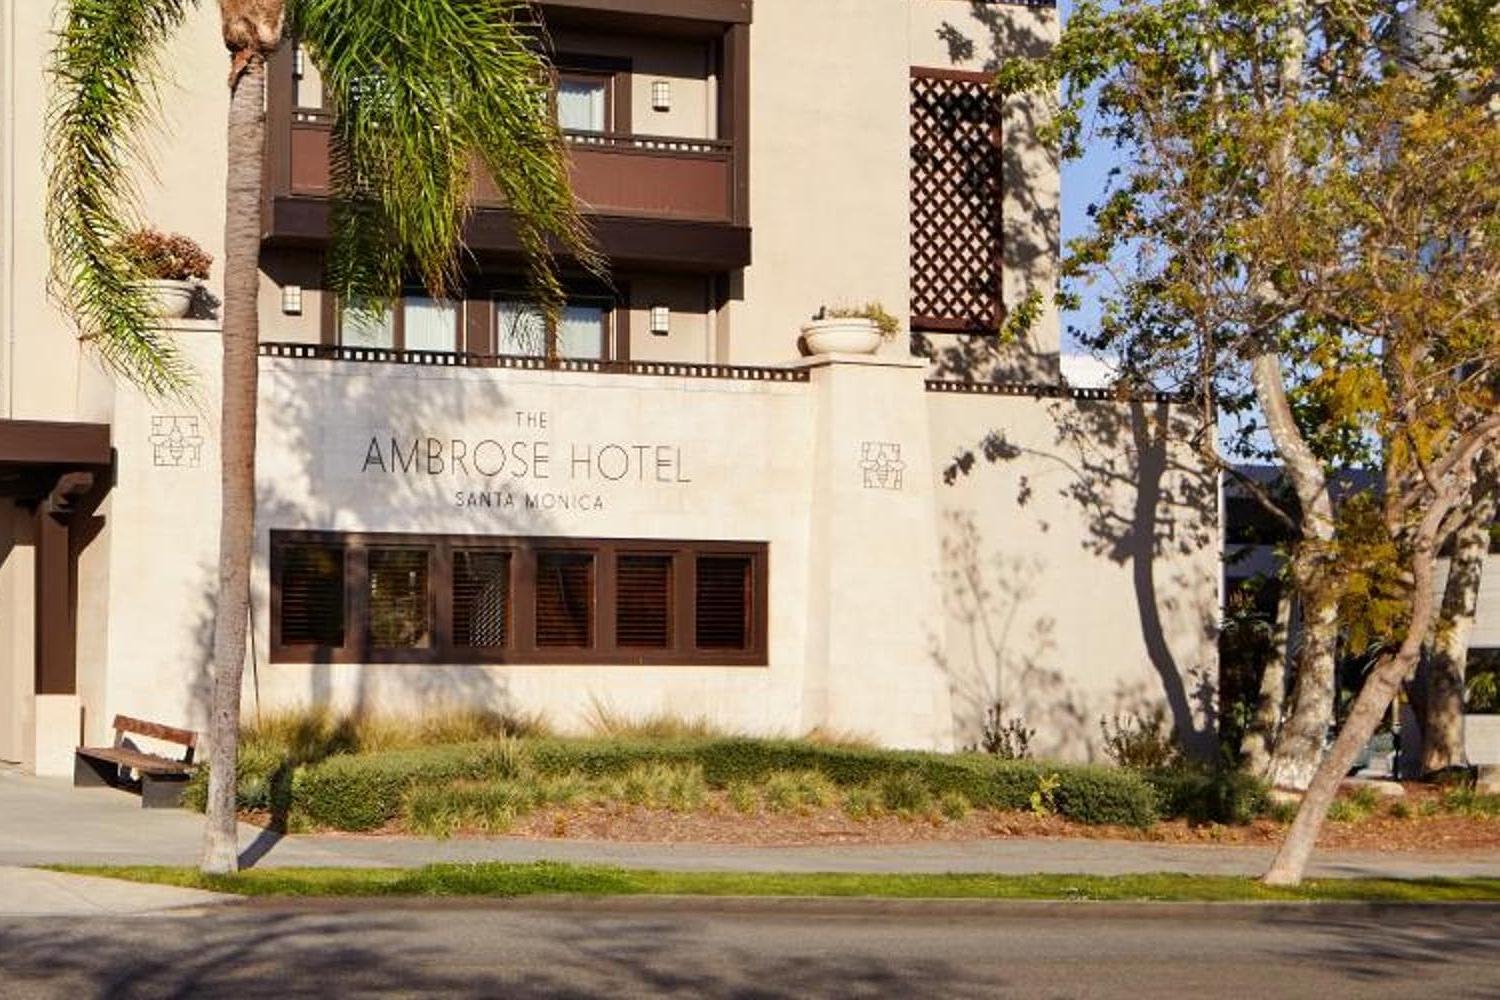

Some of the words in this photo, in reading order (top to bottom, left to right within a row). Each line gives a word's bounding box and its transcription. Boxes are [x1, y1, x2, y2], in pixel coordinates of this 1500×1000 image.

[515, 411, 548, 429] THE
[362, 436, 549, 479] AMBROSE
[571, 443, 692, 483] HOTEL
[455, 491, 515, 508] SANTA
[525, 493, 604, 511] MONICA
